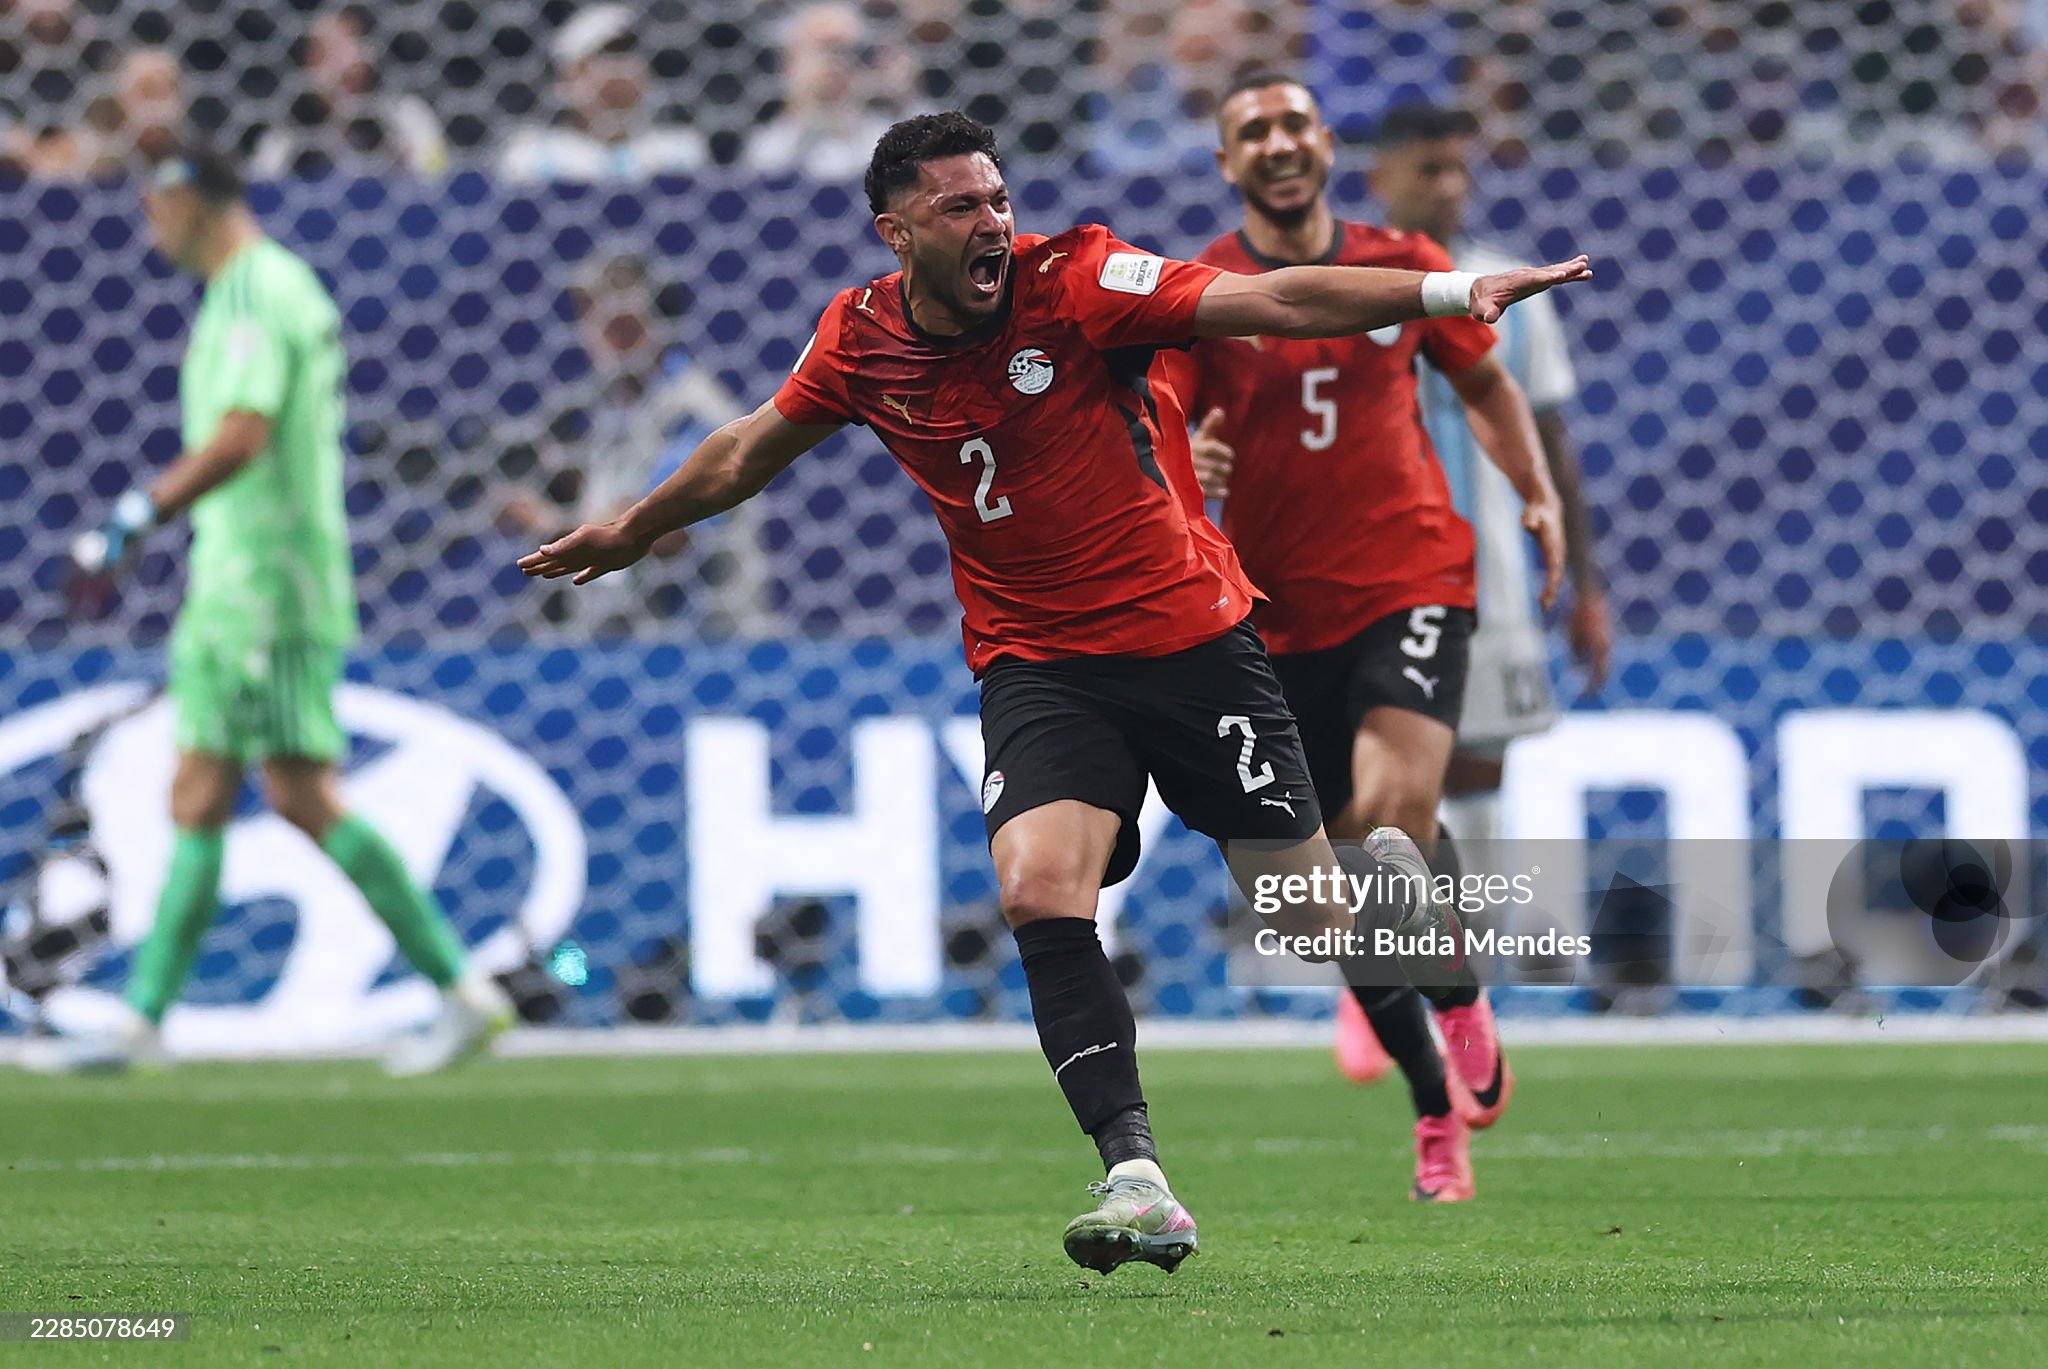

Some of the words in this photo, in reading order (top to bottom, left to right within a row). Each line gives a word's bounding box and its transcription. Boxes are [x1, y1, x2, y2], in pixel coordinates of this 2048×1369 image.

[1301, 367, 1339, 451] 5
[959, 437, 1013, 523] 2
[1400, 604, 1447, 659] 5
[1217, 715, 1275, 794] 2
[687, 712, 2033, 991] HND
